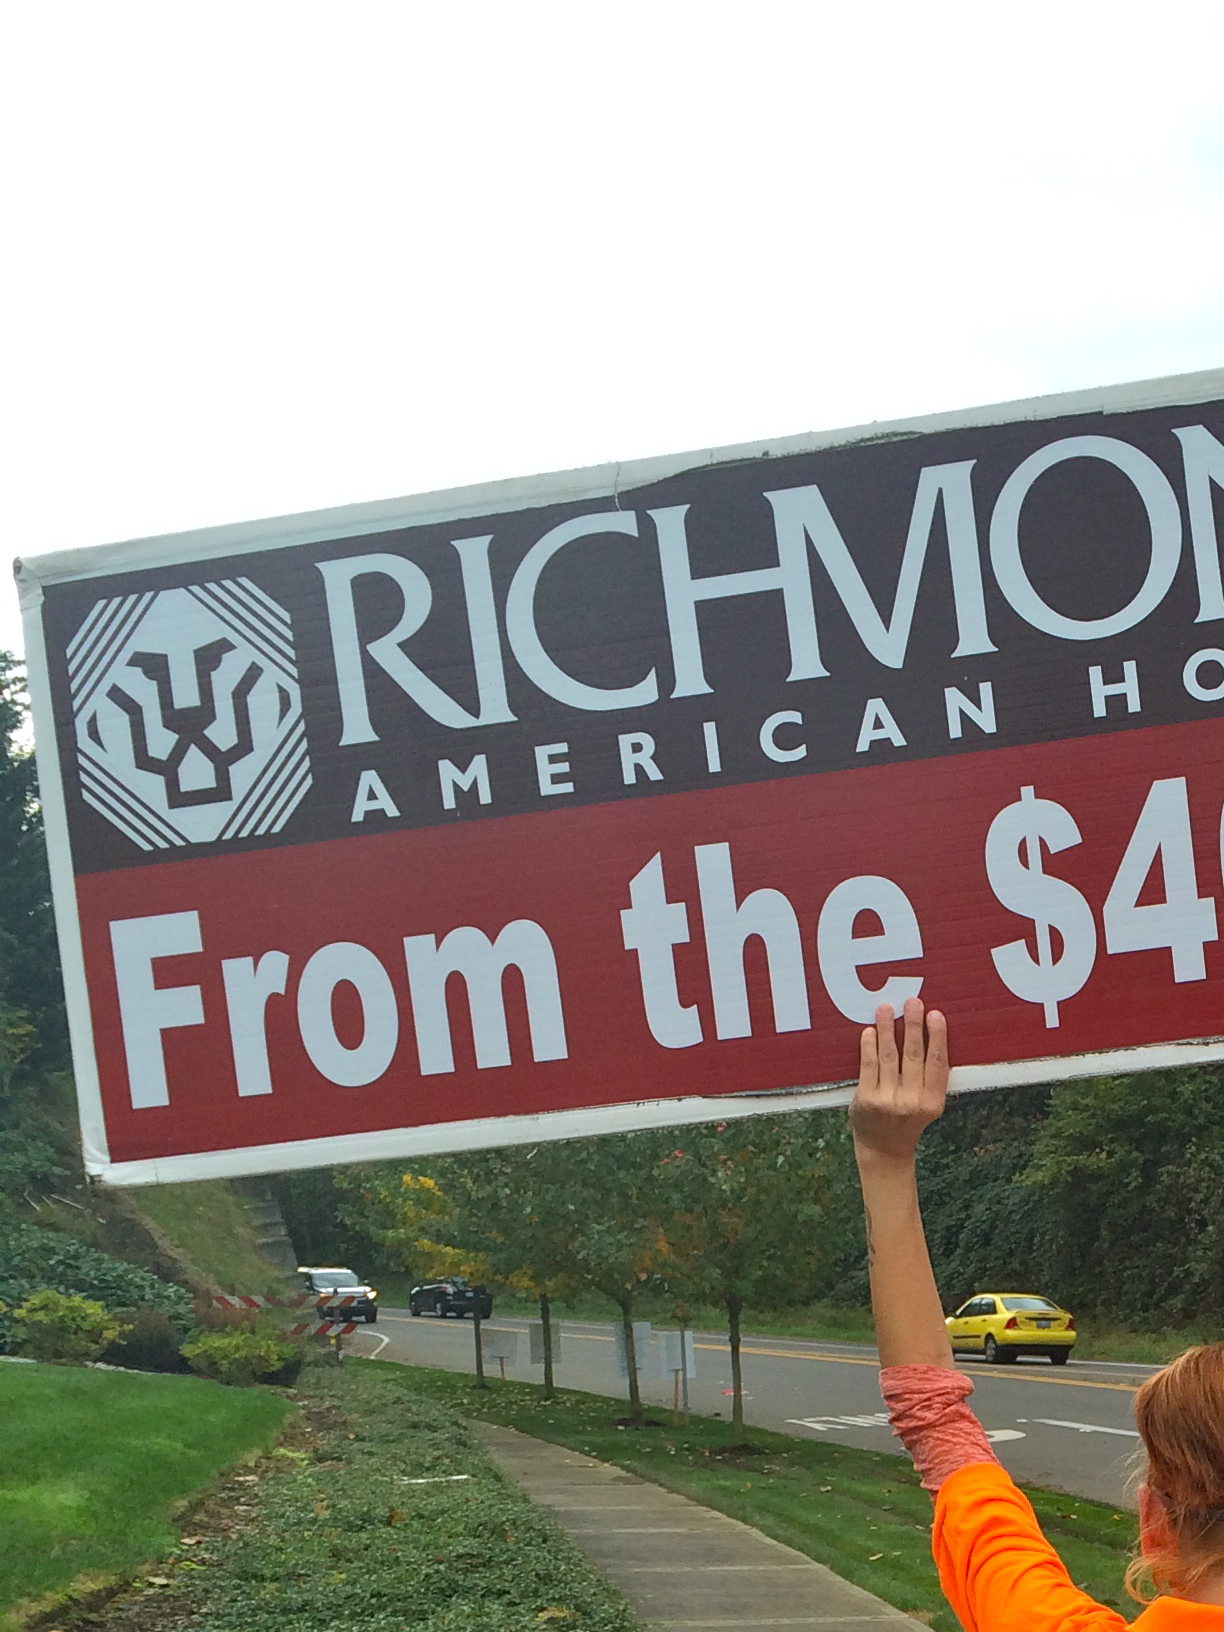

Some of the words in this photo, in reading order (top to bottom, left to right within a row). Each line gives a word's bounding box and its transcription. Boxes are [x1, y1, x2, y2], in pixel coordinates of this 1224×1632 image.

[350, 681, 997, 823] AMERICAN
[109, 910, 569, 1110] From
[619, 841, 925, 1049] the
